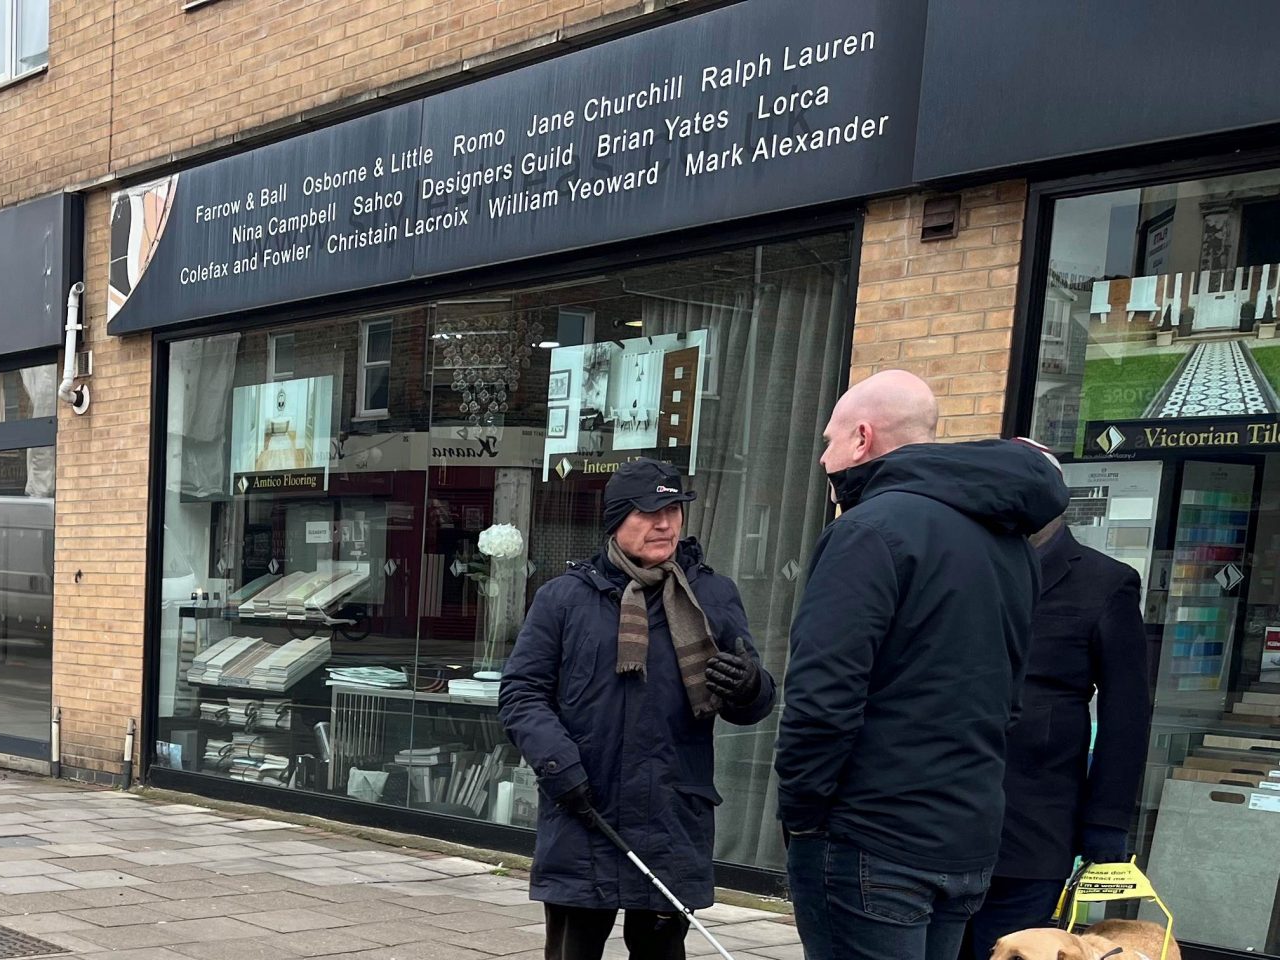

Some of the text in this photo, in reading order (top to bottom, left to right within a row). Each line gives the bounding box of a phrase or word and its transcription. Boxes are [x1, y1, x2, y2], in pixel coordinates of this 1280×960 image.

[195, 31, 875, 224] Farrow & Ball Osborne & Little Romo Jane Churchill Ralph Lauren
[232, 85, 829, 245] Nina Campbell Sahco Designers Guild Brian Yates Lorca
[180, 115, 889, 285] Colefax and Fowler Christain Lacroix William Yeoward Mark Alexander
[253, 473, 317, 488] Amtico Flooring
[583, 457, 631, 474] Intern
[1144, 426, 1239, 447] Victorian
